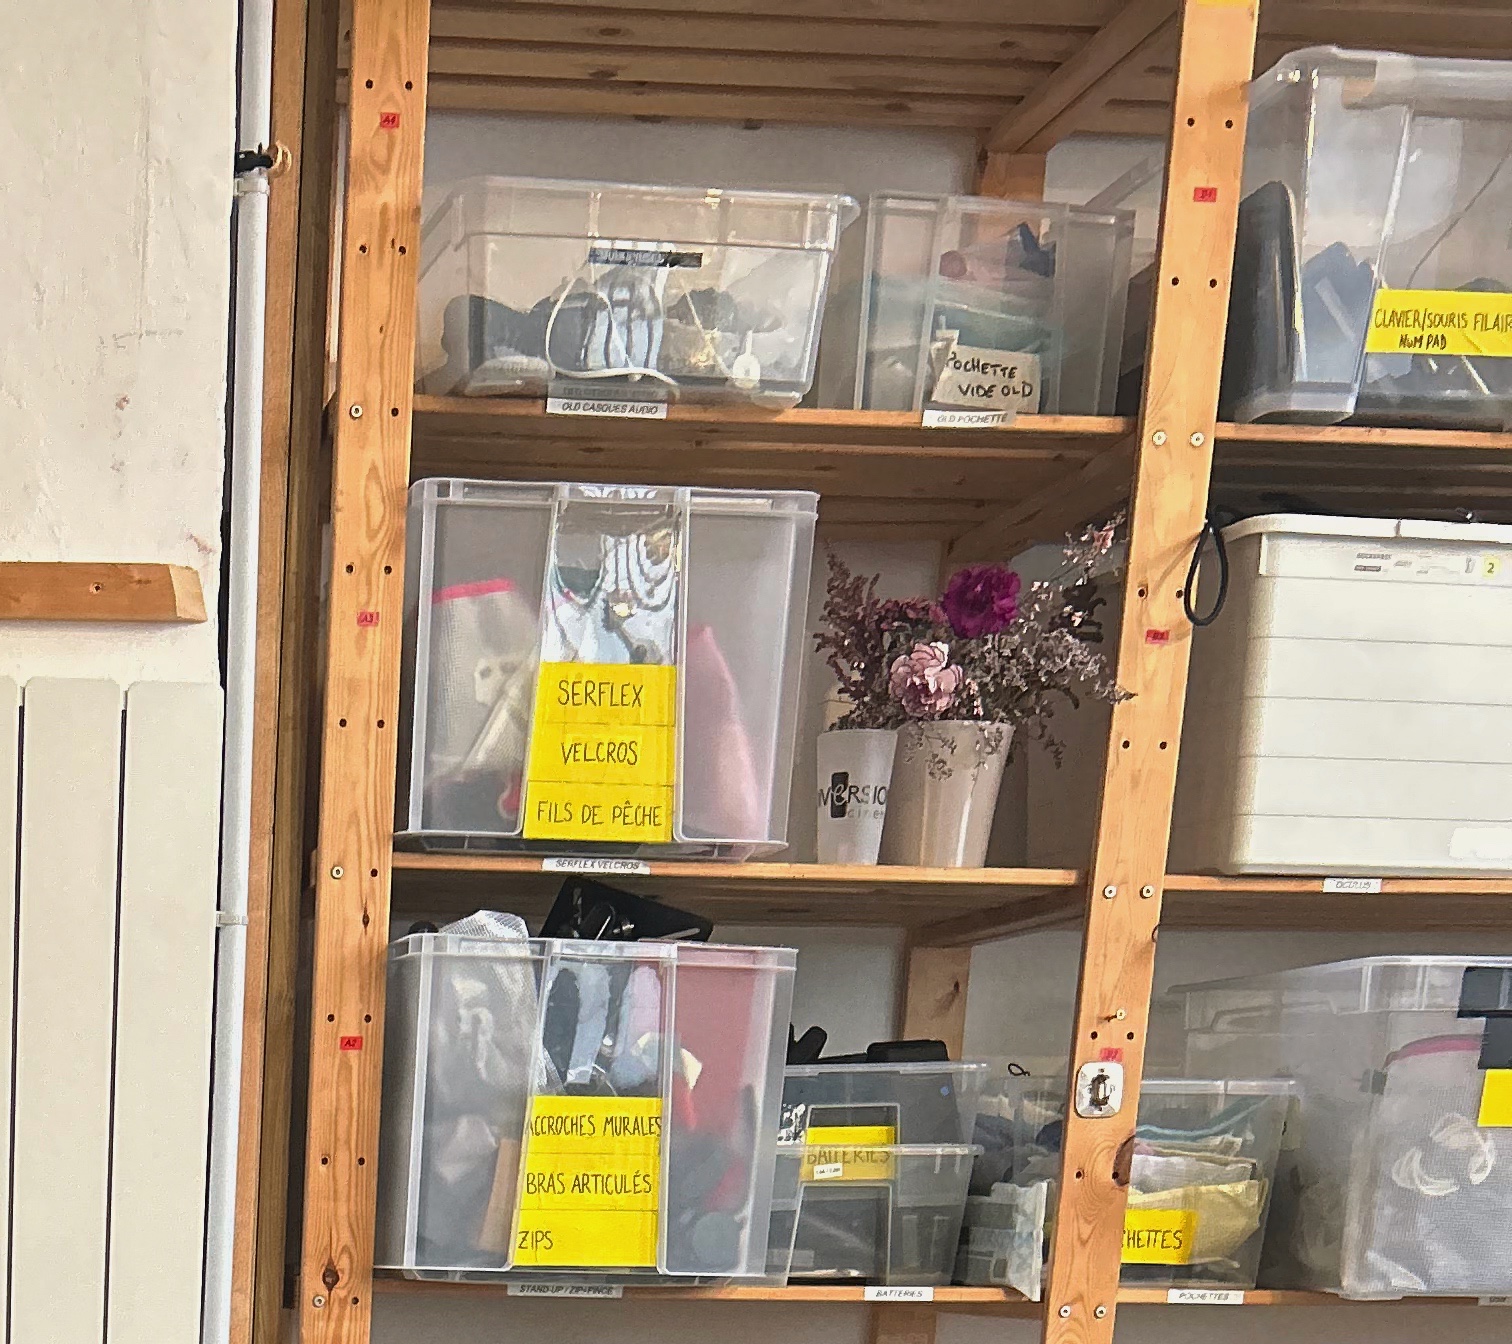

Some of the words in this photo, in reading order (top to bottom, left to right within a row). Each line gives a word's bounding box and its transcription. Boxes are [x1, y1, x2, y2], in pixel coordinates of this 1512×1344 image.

[957, 383, 997, 399] VIDE
[1000, 380, 1033, 398] OLD
[1486, 562, 1496, 574] 2
[557, 679, 644, 708] SERFLEX
[560, 740, 638, 766] VELCROS
[537, 800, 573, 824] FILS
[581, 804, 605, 826] DE
[611, 800, 663, 827] PÊCHE
[527, 1172, 566, 1196] BRAS
[571, 1169, 652, 1196] ARTICULÉS
[517, 1230, 554, 1251] ZIPS
